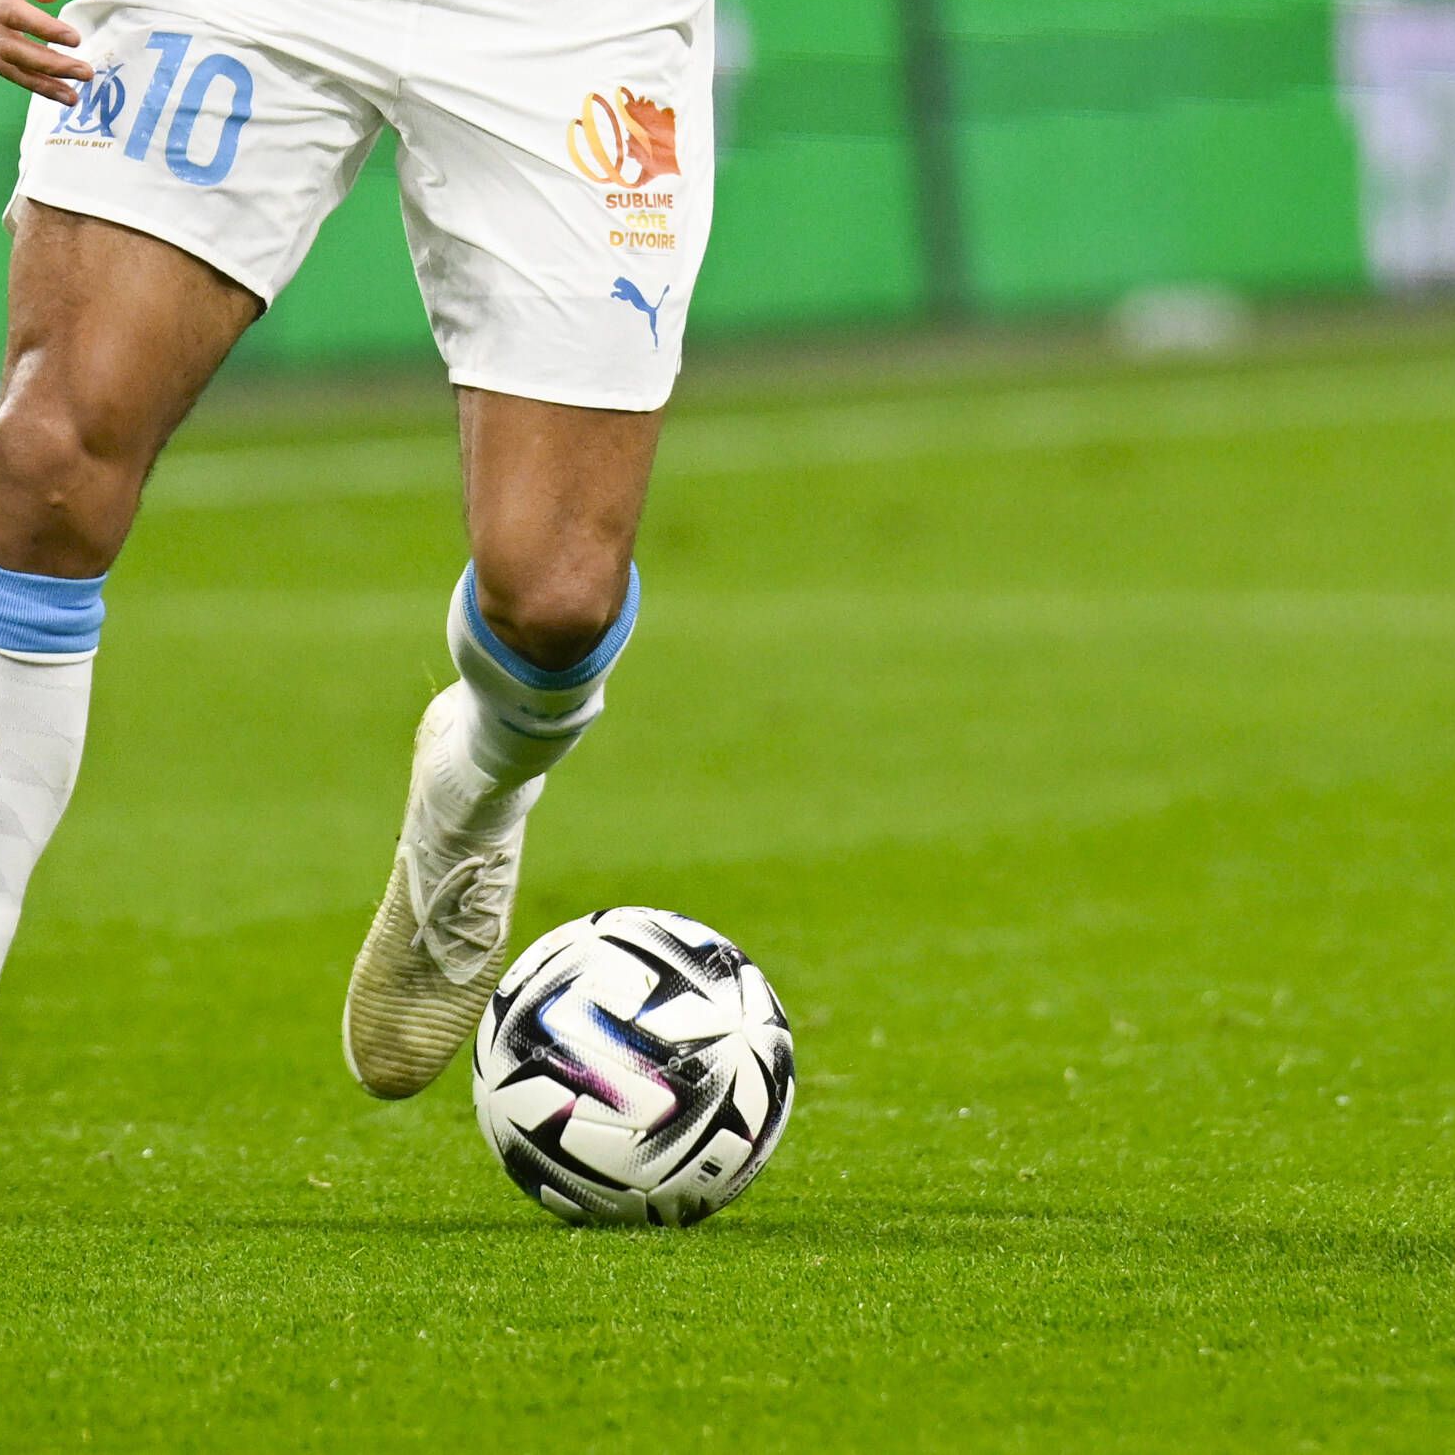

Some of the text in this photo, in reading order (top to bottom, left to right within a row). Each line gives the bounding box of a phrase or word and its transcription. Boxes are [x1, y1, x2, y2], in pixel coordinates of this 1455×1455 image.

[123, 31, 254, 187] 10
[74, 139, 89, 147] AU
[605, 193, 674, 210] SUBLIME
[625, 209, 667, 230] CÔTE
[609, 230, 676, 249] D'IVOIRE
